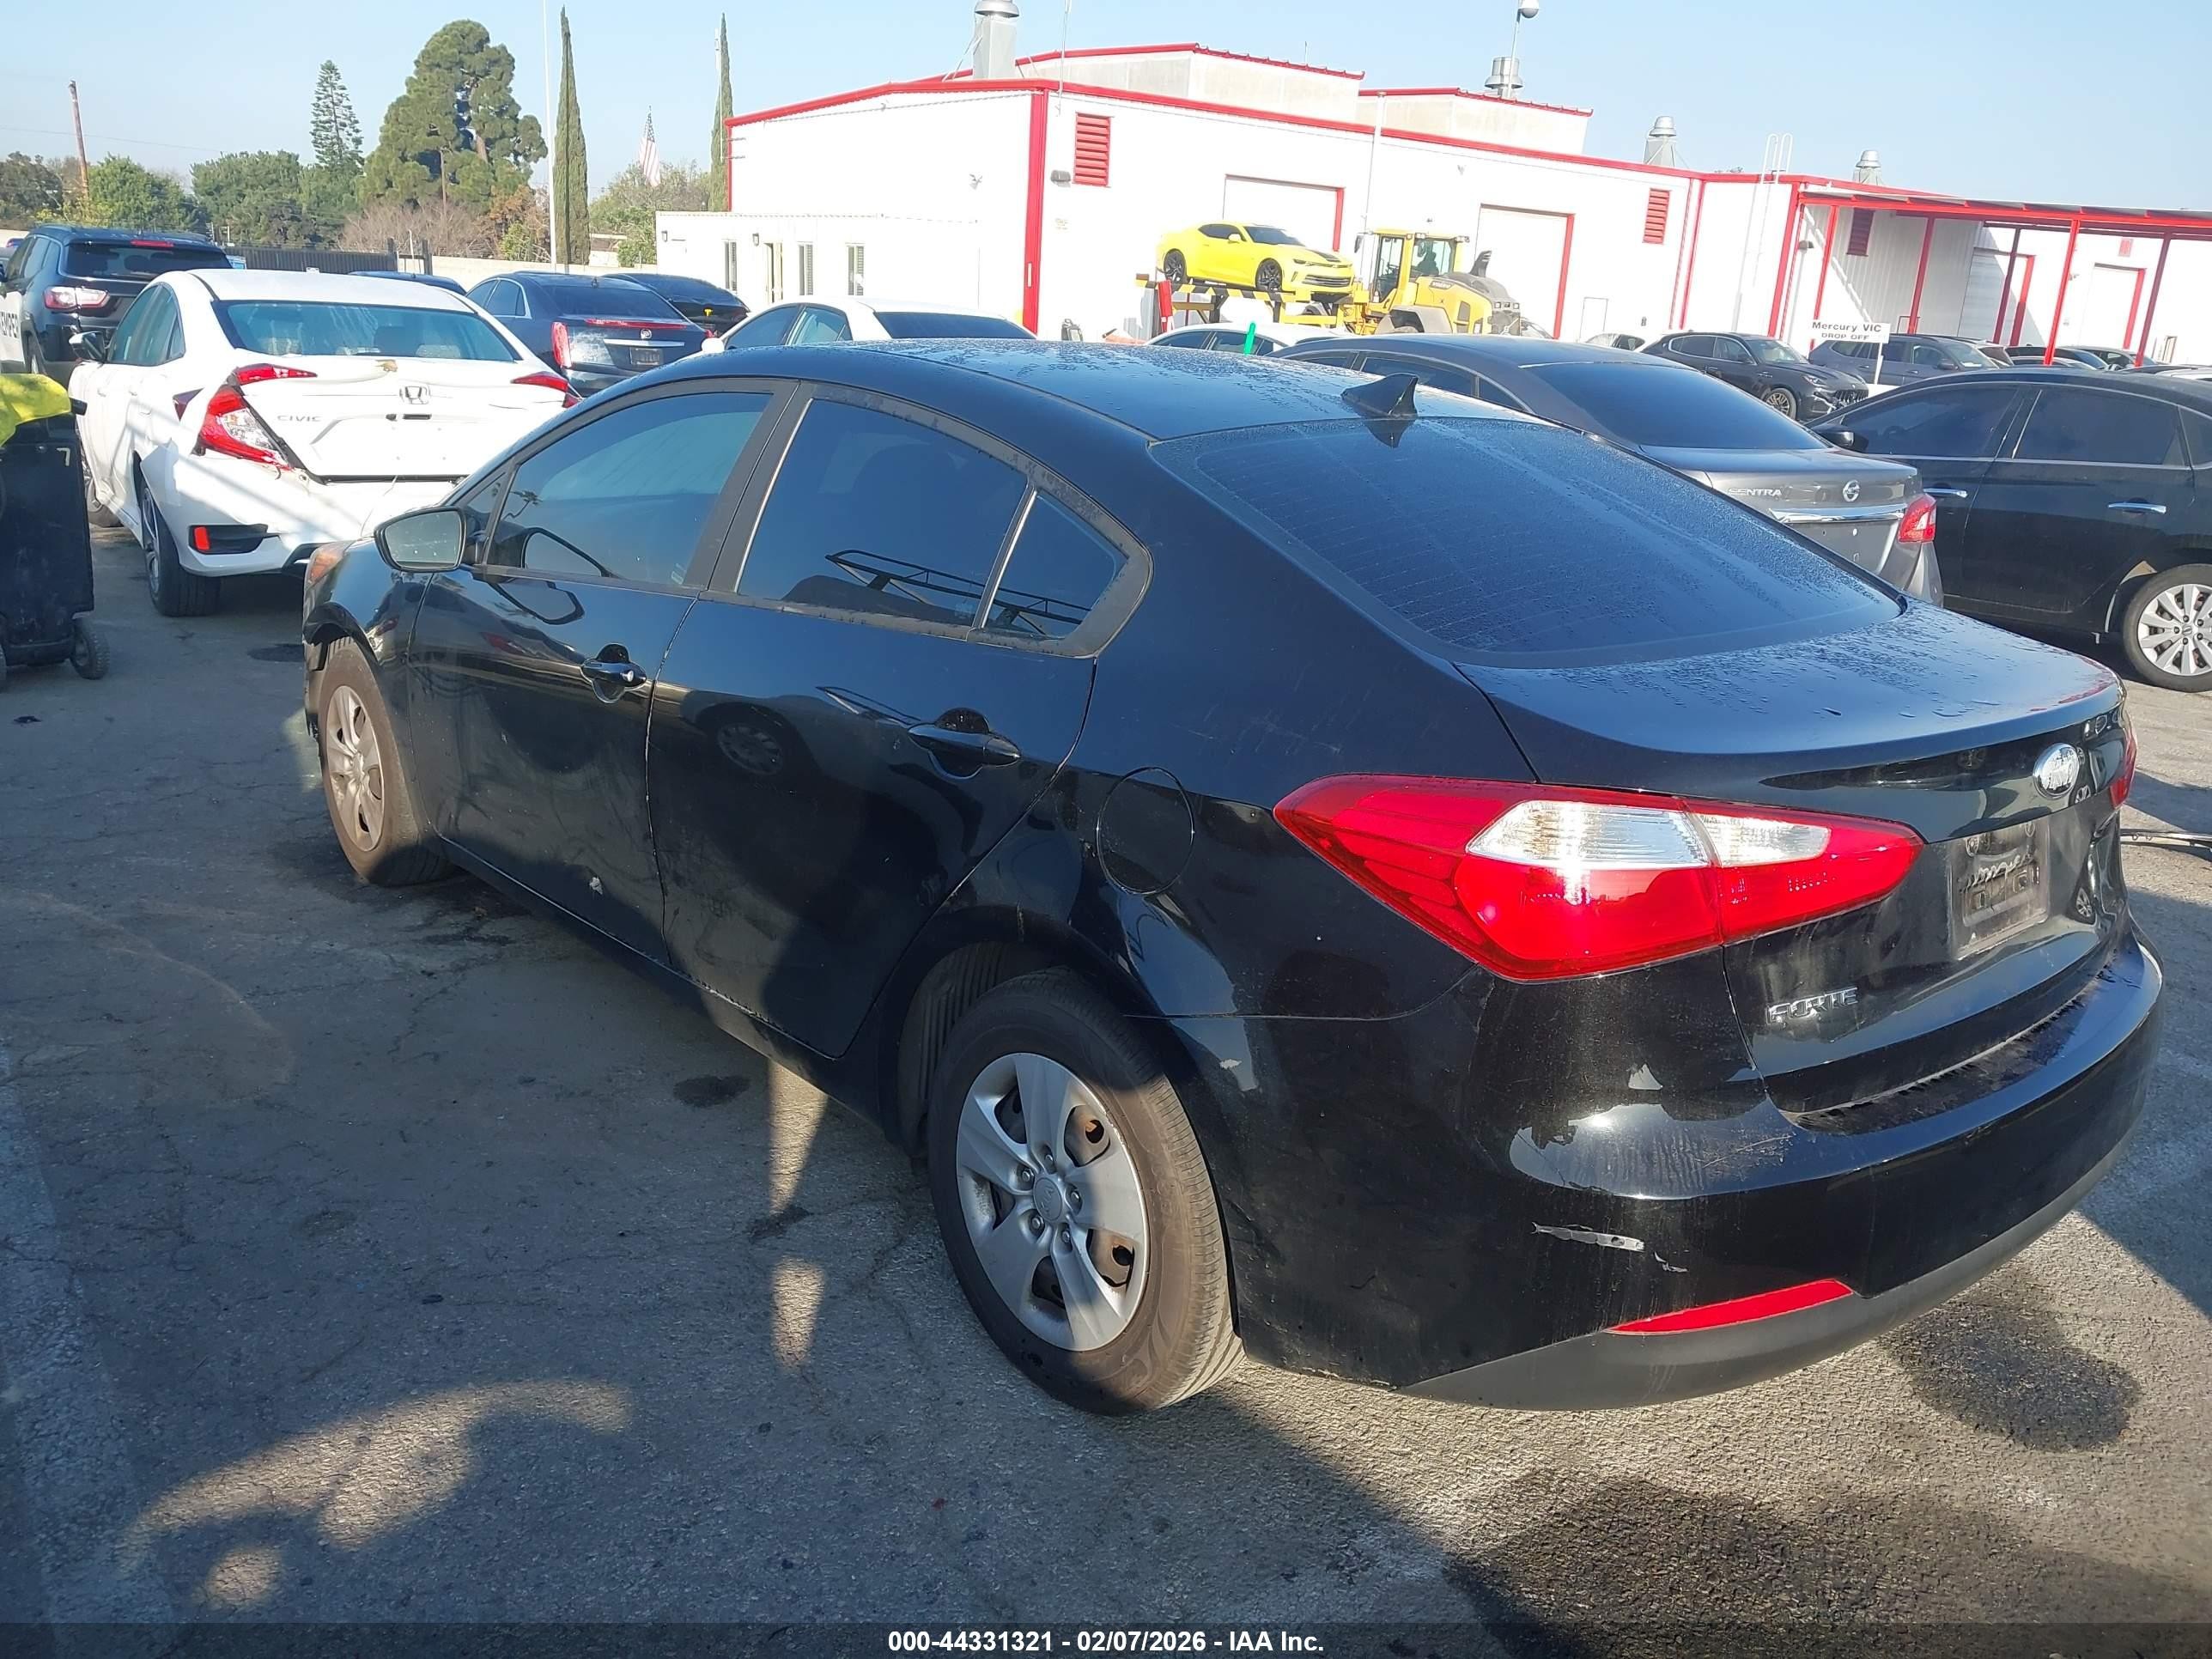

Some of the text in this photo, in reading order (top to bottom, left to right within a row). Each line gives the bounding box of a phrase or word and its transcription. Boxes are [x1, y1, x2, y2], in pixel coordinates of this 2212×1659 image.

[1812, 321, 1881, 332] Mercury VIC
[1728, 488, 1783, 497] SENTRA
[1765, 987, 1858, 1025] FORTE
